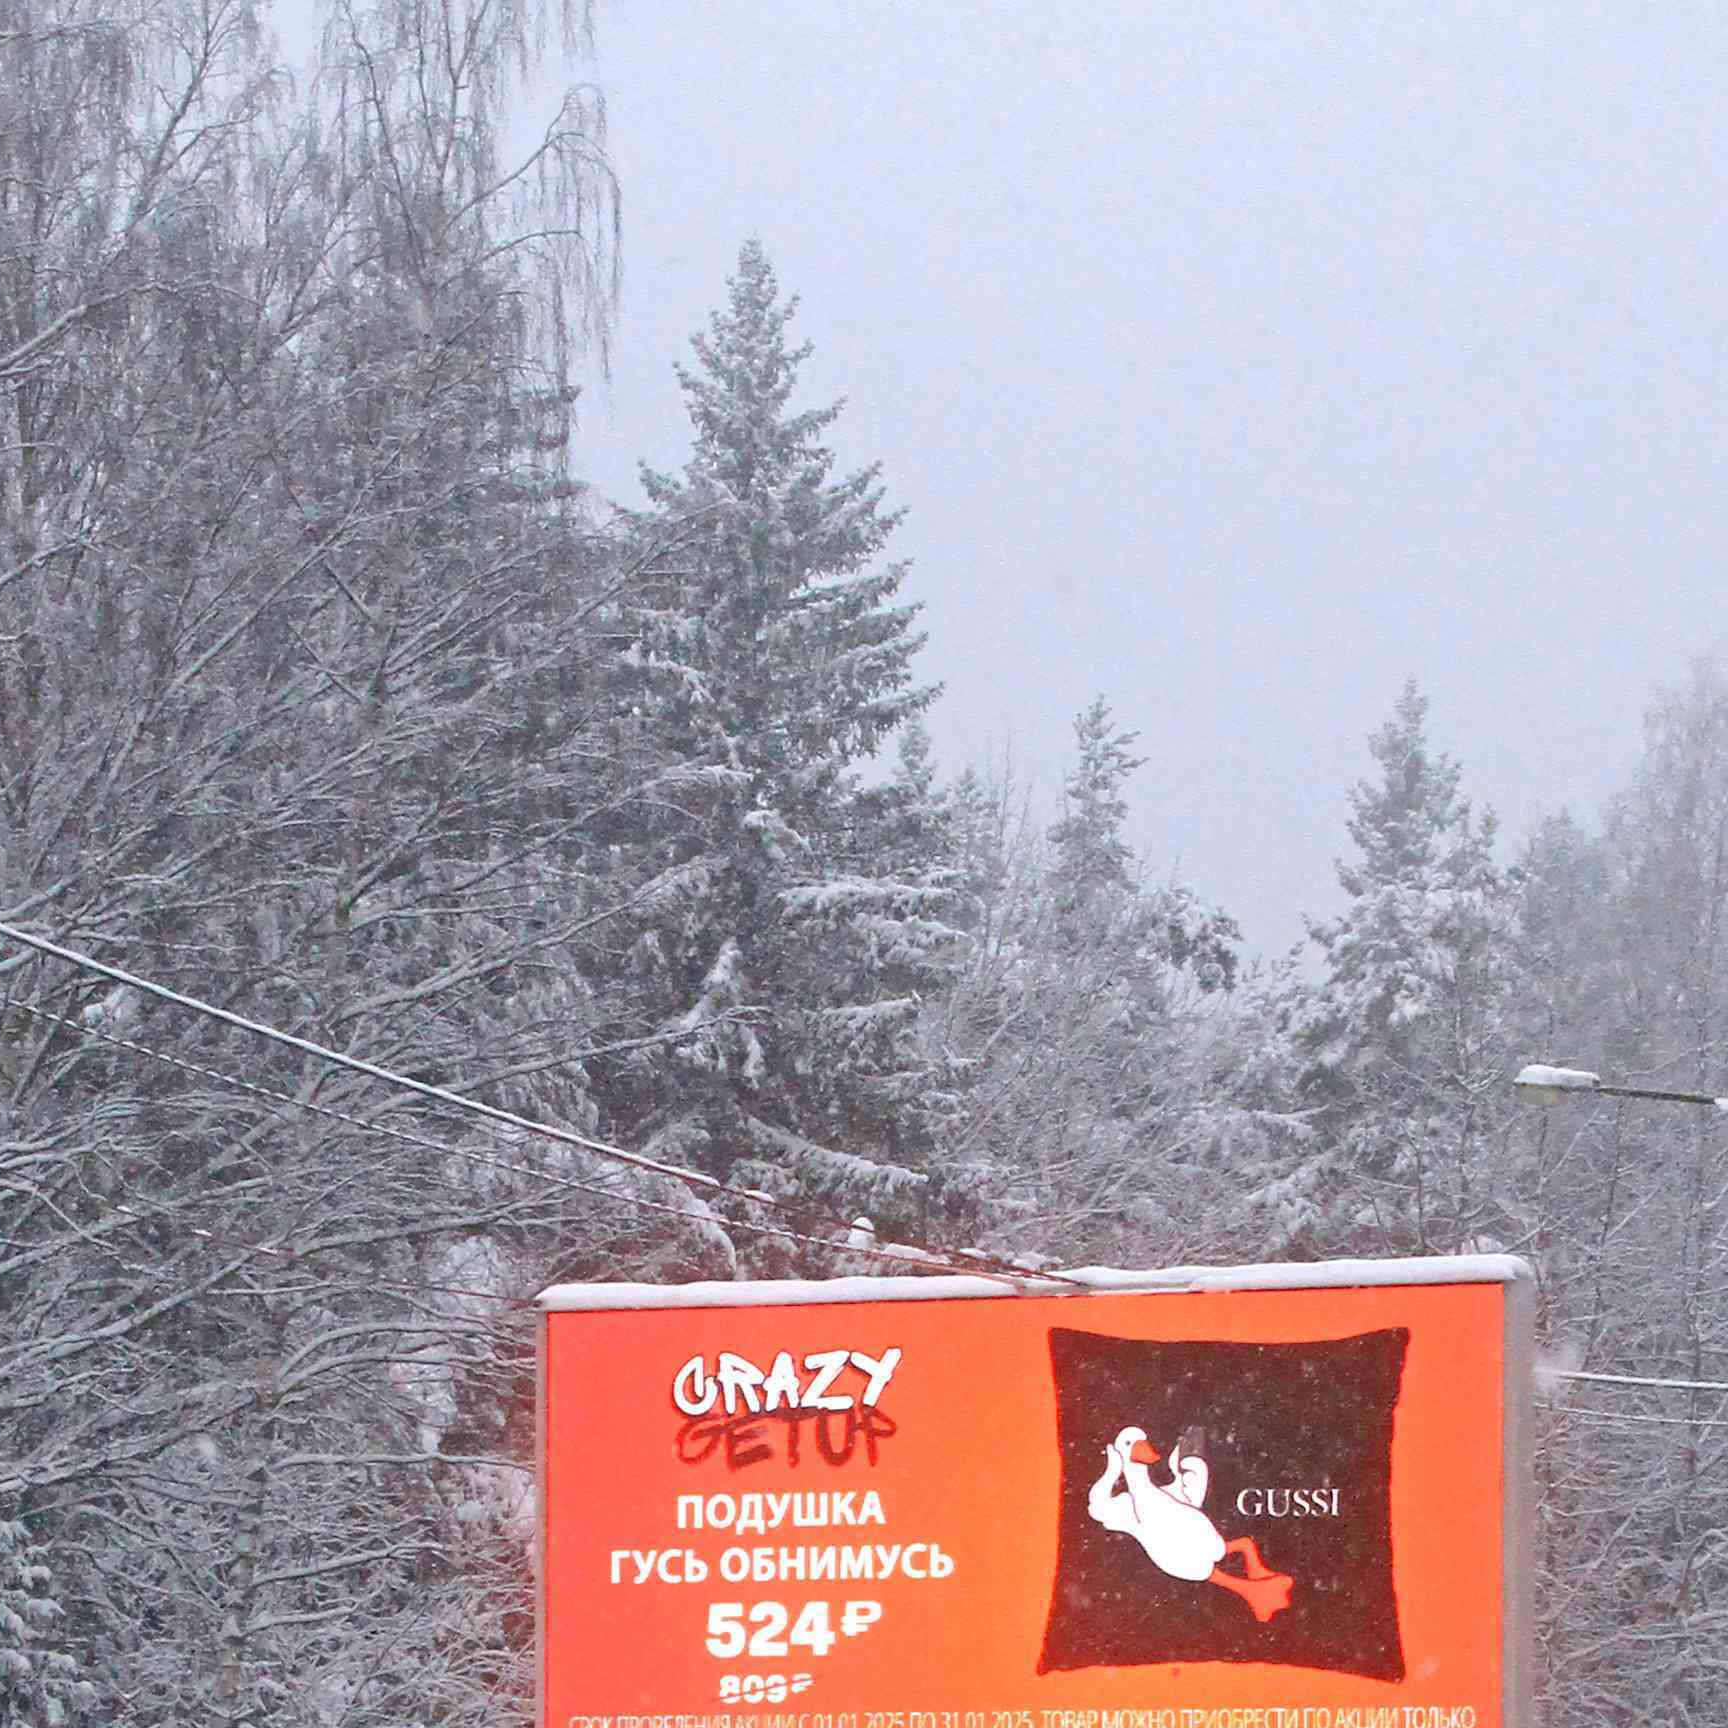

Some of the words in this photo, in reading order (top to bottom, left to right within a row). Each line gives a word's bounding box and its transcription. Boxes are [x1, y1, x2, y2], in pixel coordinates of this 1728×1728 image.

[673, 1347, 902, 1416] CRAZY
[676, 1490, 886, 1536] ПОДУШКА
[1236, 1487, 1340, 1517] GUSSI
[610, 1549, 709, 1584] ГУСЬ
[719, 1543, 955, 1582] ОБНИМУСЬ
